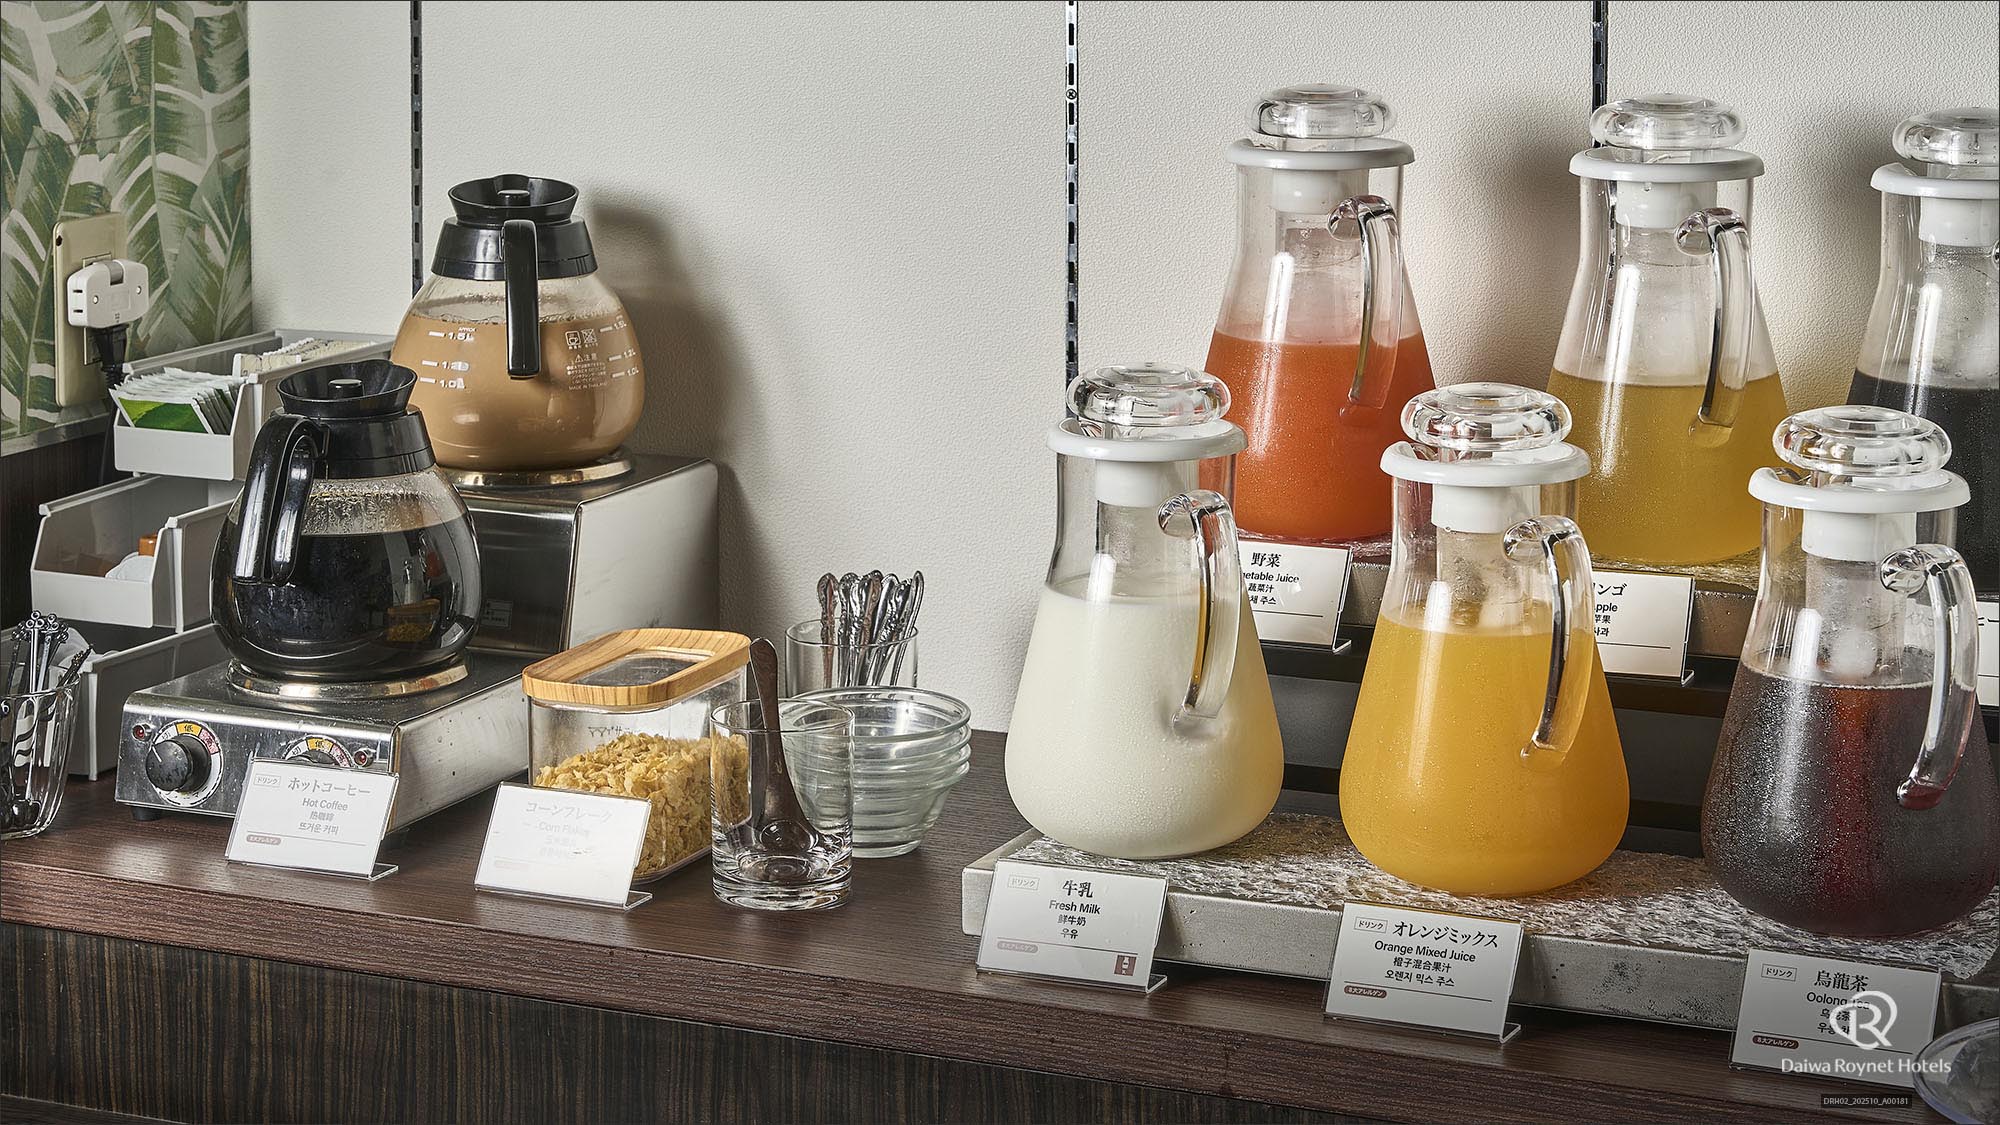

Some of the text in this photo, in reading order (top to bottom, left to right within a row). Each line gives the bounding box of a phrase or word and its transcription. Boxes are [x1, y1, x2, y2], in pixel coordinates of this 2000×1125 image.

[1251, 552, 1282, 567] 野菜
[1276, 573, 1300, 583] Juice
[1594, 603, 1618, 613] pple
[256, 777, 278, 785] ドリンク
[288, 778, 371, 796] ホットコーヒー
[302, 798, 348, 811] Hot Coffee
[323, 825, 339, 835] 커피
[1011, 878, 1036, 888] ドリンク
[1063, 879, 1094, 898] 牛乳
[1049, 900, 1101, 915] Fresh Milk
[1358, 920, 1384, 930] ドリンク
[1060, 928, 1078, 940] 우유
[1393, 921, 1498, 948] オレンジミックス
[1374, 940, 1476, 962] Orange Mixed Juice
[1393, 957, 1452, 973] 橙子混合果汁
[1385, 969, 1455, 987] 오렌지 믹스 주스
[1764, 968, 1793, 979] ドリンク
[1814, 970, 1870, 993] 烏龍茶
